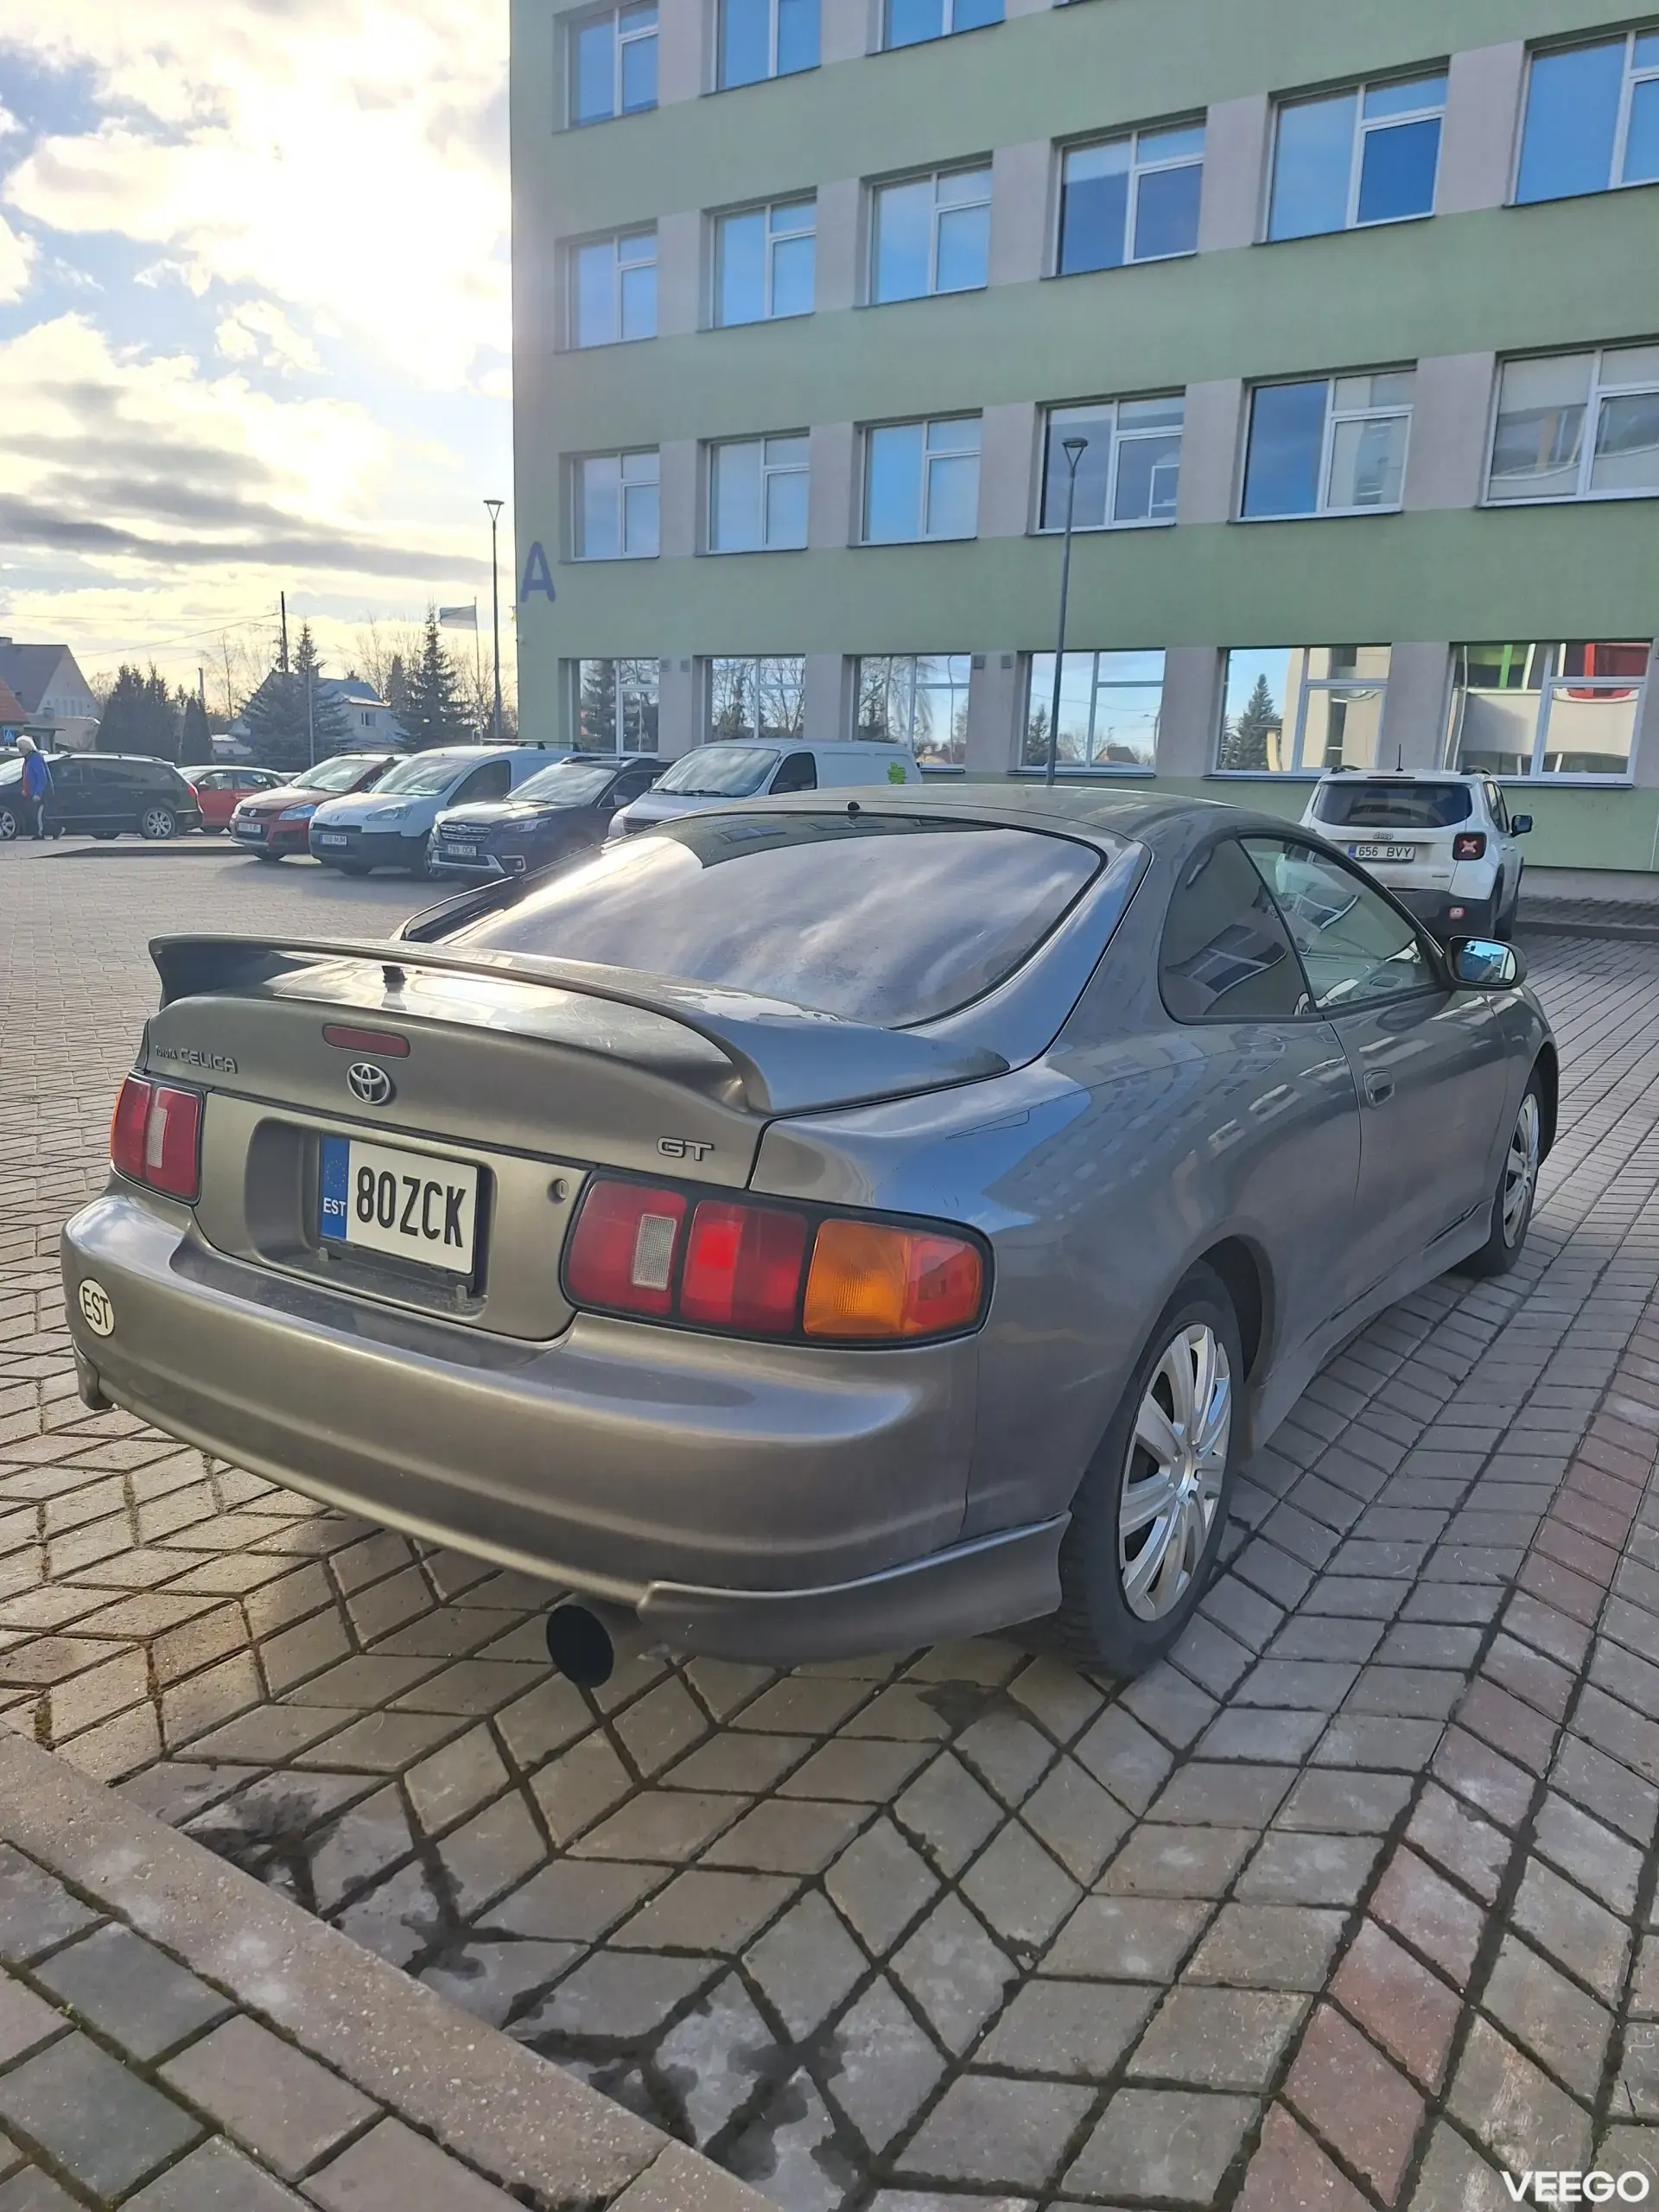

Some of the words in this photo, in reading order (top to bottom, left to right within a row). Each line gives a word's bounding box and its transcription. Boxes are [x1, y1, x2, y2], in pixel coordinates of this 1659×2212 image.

[520, 541, 556, 603] A
[1358, 847, 1378, 856] 656
[1387, 847, 1412, 857] BVY
[156, 1045, 177, 1059] TOYOTA
[180, 1047, 238, 1074] CELICA
[657, 1136, 715, 1161] GT
[323, 1197, 346, 1217] EST
[356, 1166, 467, 1248] 80ZCK
[82, 1286, 109, 1329] EST
